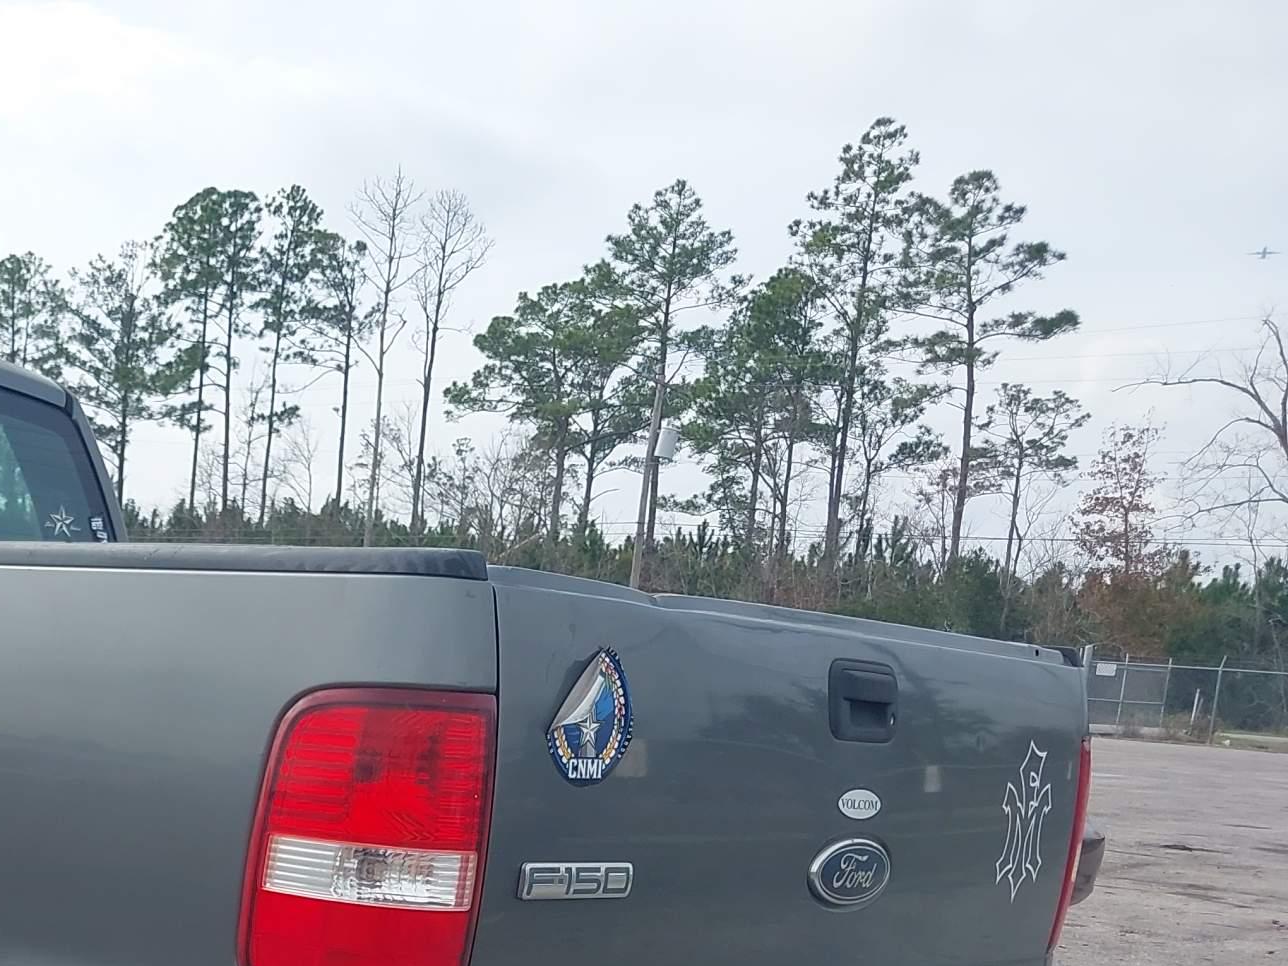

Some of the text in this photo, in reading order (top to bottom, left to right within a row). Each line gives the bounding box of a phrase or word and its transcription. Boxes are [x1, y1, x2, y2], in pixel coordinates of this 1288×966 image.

[567, 758, 603, 779] CNMI
[840, 798, 879, 811] VOLCOM
[525, 866, 630, 897] F-150
[832, 852, 879, 889] Ford
